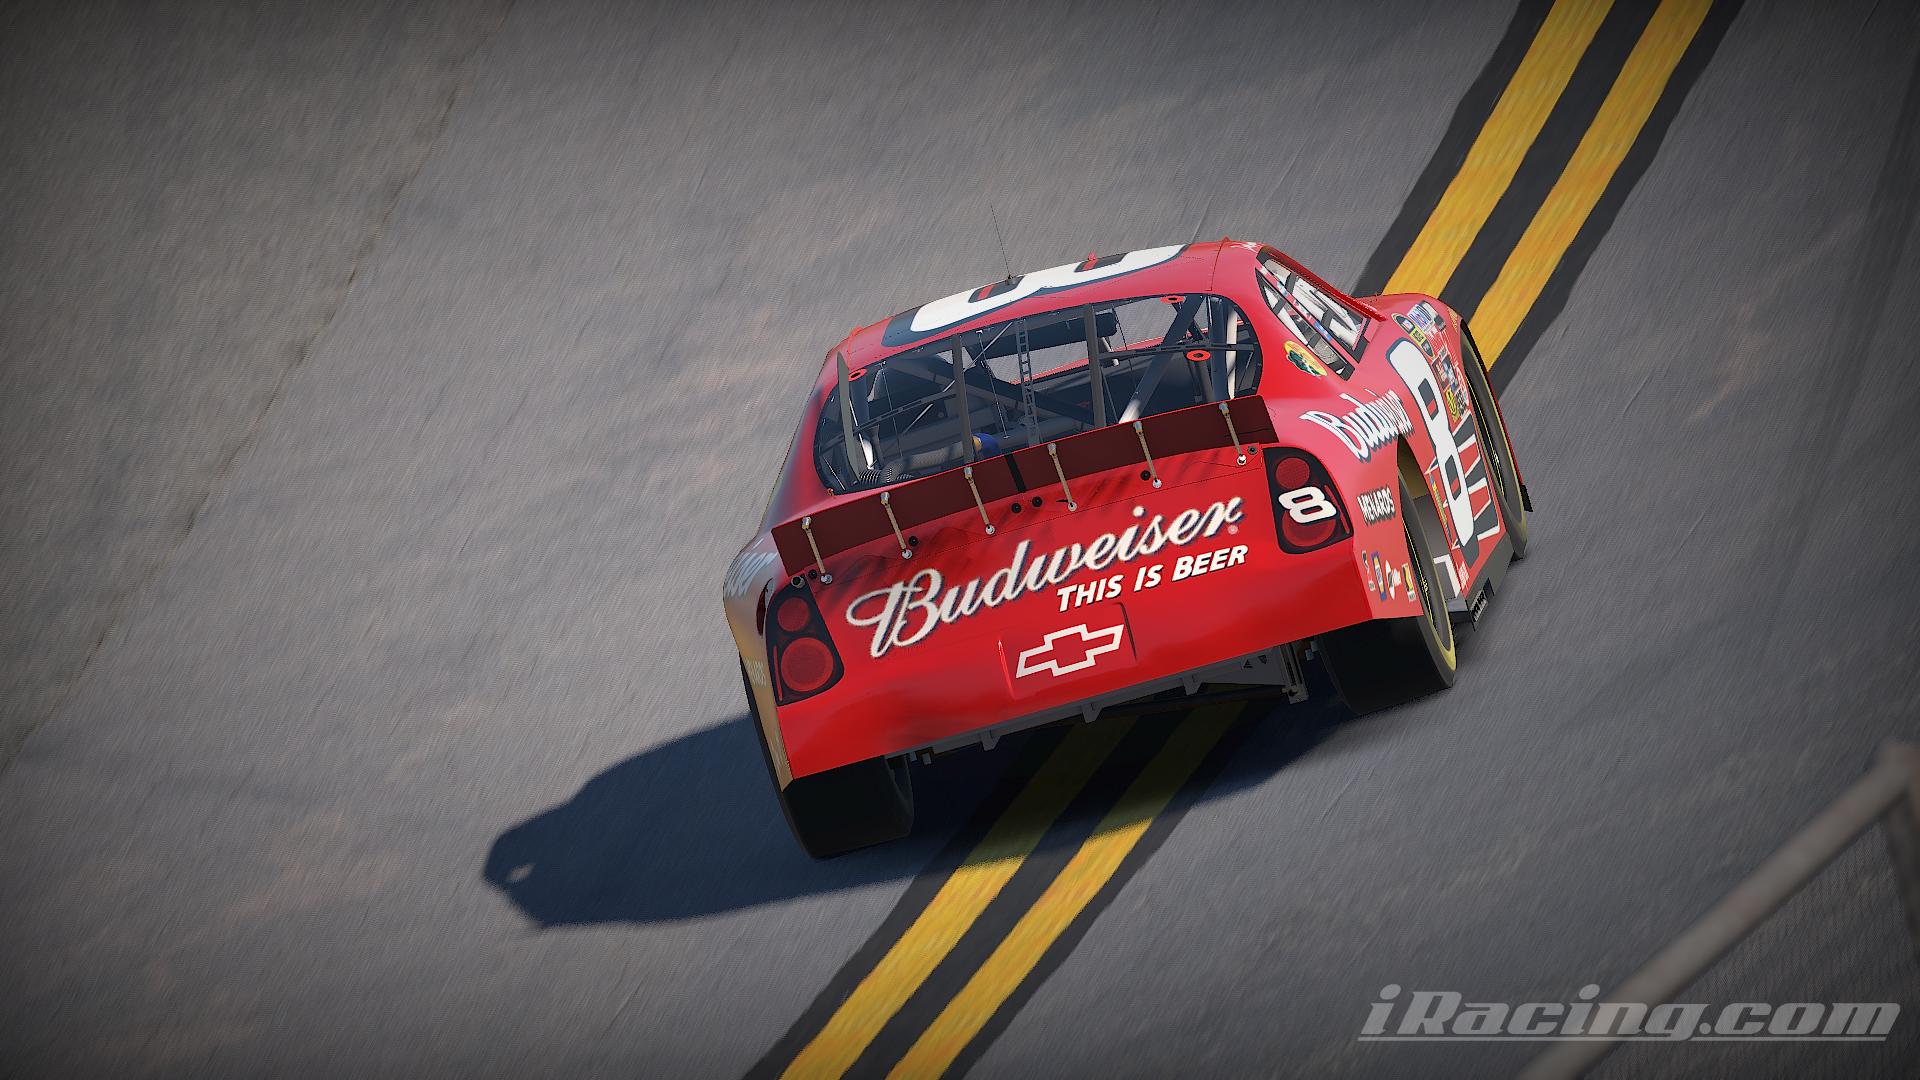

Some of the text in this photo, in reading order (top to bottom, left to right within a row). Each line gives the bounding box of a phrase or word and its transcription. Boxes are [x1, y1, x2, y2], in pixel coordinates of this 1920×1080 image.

[1389, 340, 1475, 547] 8
[1278, 486, 1337, 524] 8
[845, 496, 1244, 659] Budweiser
[1056, 545, 1249, 613] THIS IS BEER
